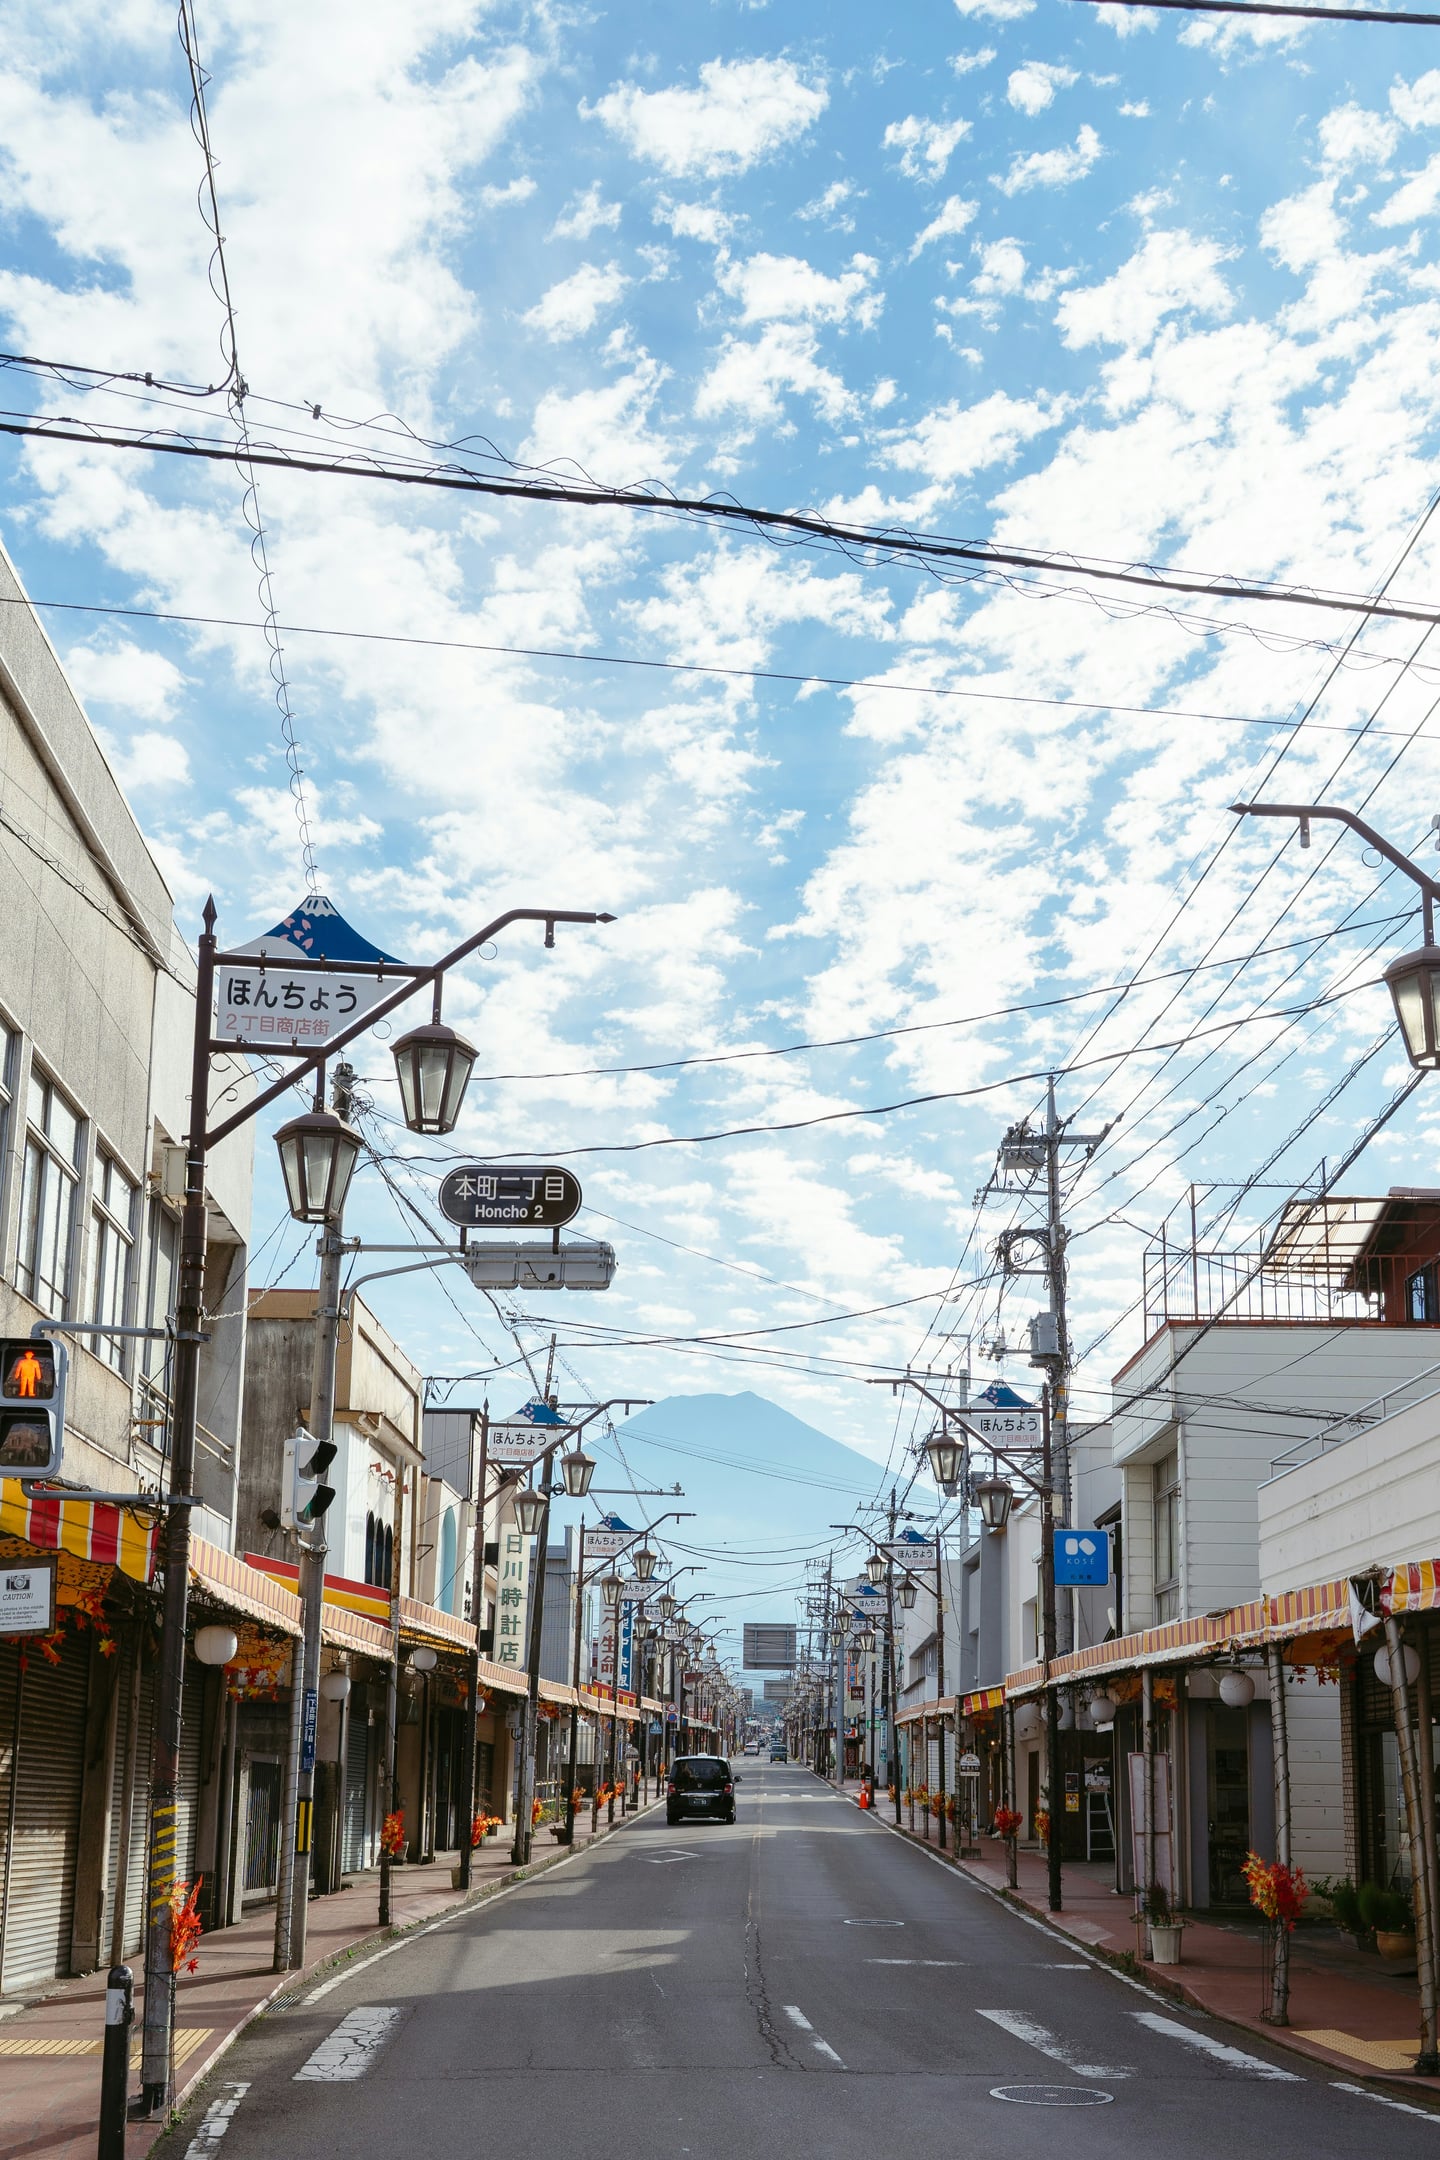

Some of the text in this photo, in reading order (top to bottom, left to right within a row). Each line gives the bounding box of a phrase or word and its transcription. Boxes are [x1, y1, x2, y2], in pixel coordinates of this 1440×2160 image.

[227, 978, 359, 1014] ほんちょう
[454, 1175, 565, 1202] 本町二丁目
[474, 1204, 544, 1219] Honcho 2
[980, 1417, 1038, 1432] ほんちょう
[493, 1432, 547, 1446] ほんちょう
[587, 1536, 624, 1546] ほんちょう
[897, 1549, 933, 1559] ほんちょう
[1066, 1557, 1095, 1566] KOSÉ
[498, 1534, 524, 1662] 日川時計店
